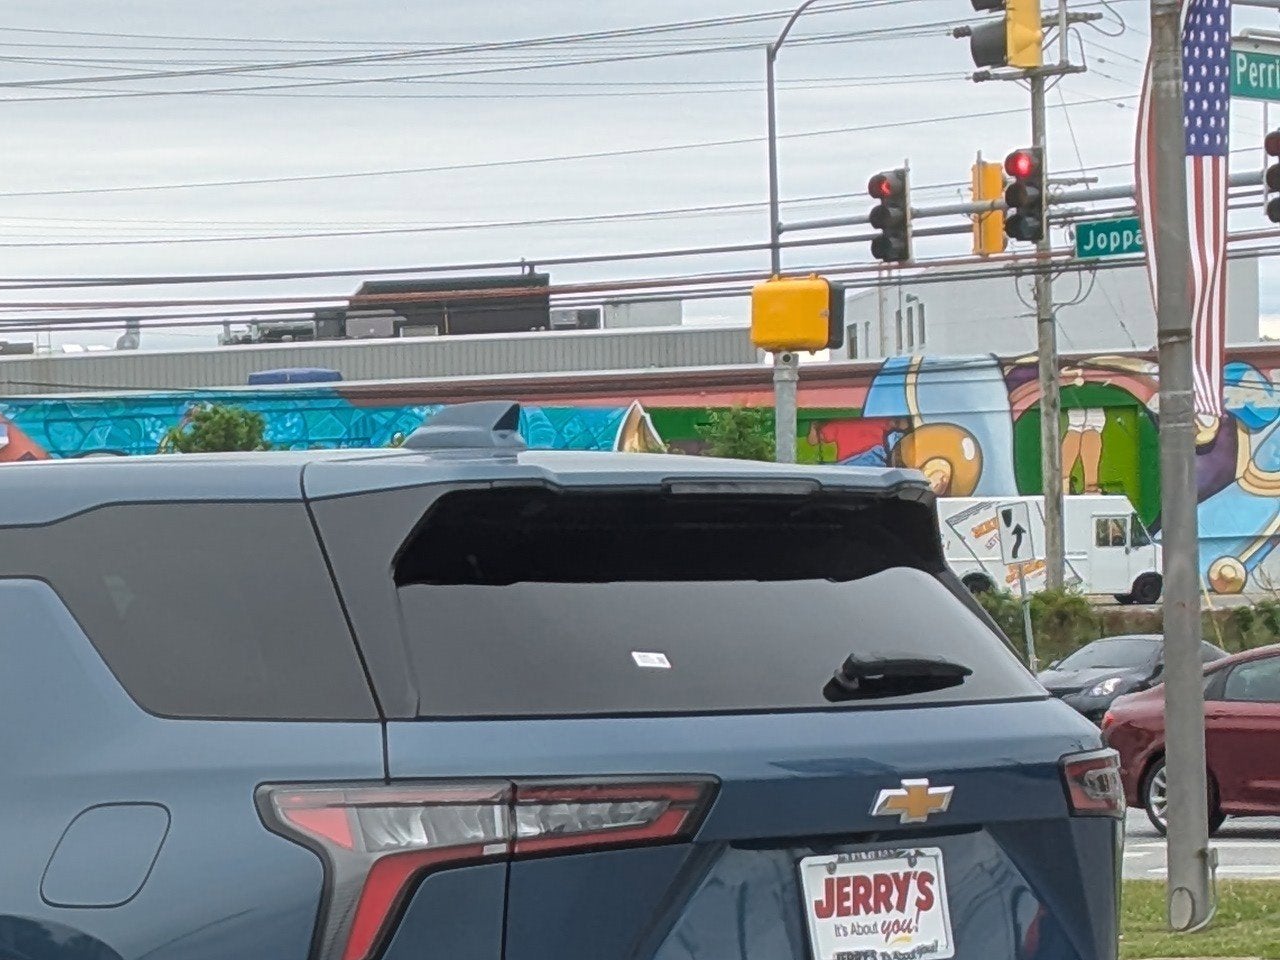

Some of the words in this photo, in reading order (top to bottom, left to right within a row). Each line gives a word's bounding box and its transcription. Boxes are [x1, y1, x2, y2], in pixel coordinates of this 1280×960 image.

[1083, 229, 1144, 251] Joppa
[814, 870, 935, 919] JERRY'S
[834, 923, 849, 937] It's
[850, 921, 879, 936] About
